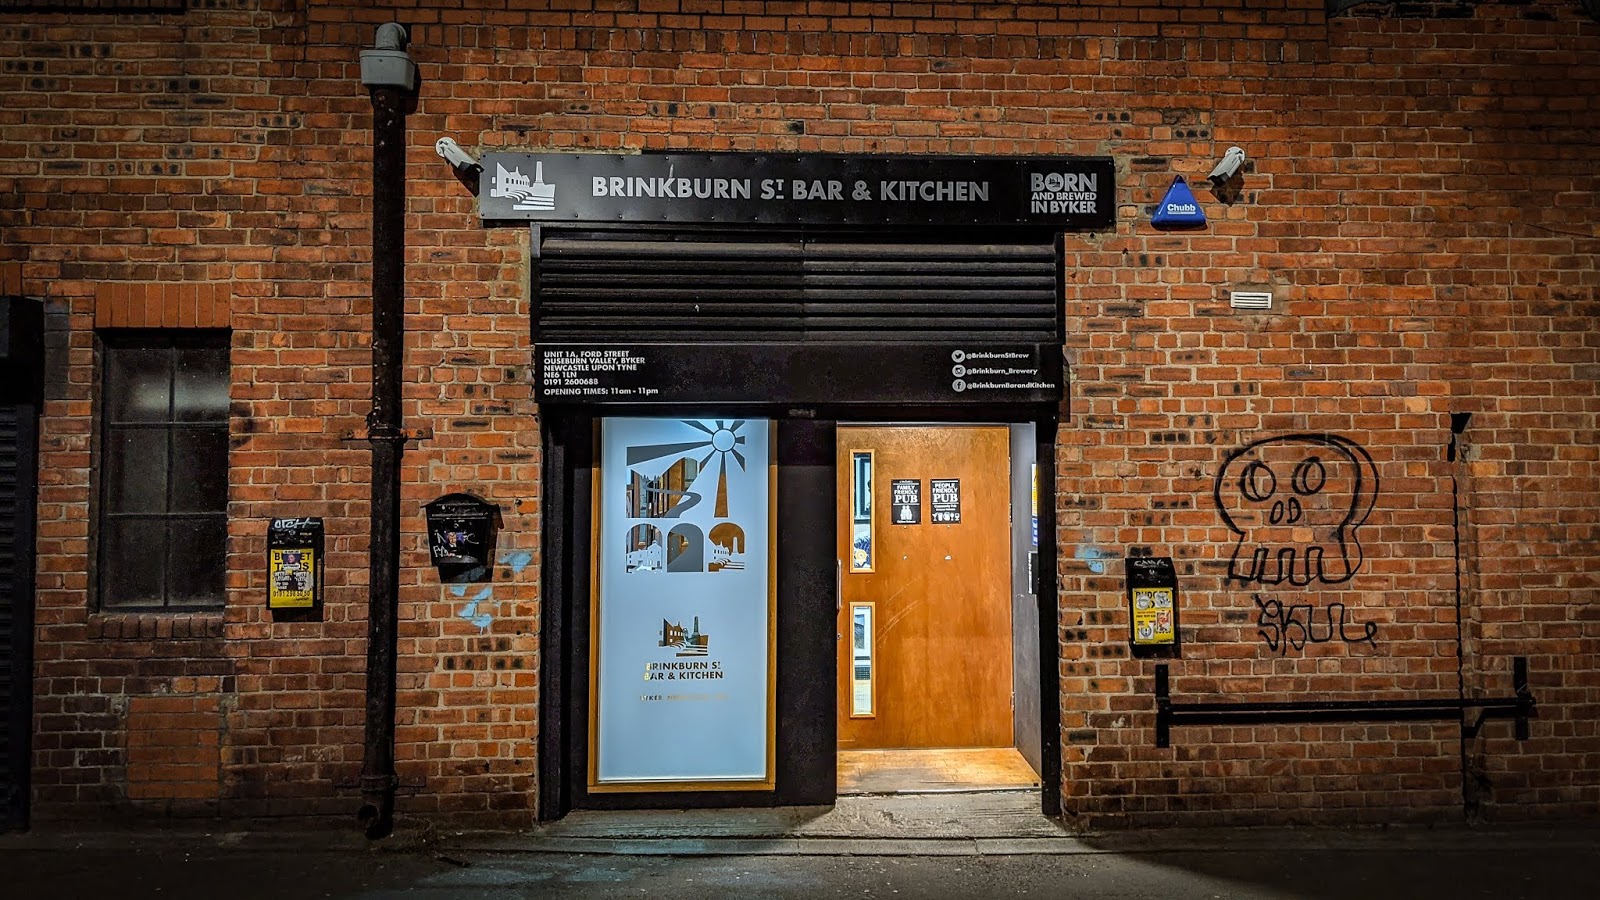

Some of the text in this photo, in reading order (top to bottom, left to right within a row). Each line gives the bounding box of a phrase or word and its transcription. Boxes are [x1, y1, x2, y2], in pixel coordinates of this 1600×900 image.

[1030, 172, 1098, 192] BORN
[592, 176, 751, 199] BRINKBURN
[793, 180, 844, 201] BAR
[852, 180, 872, 201] &
[881, 180, 990, 202] KITCHEN
[1031, 192, 1097, 201] AND BREWED
[1031, 201, 1097, 214] IN BYKER
[1167, 203, 1196, 212] Chubb
[638, 387, 659, 396] 11pm
[895, 495, 918, 503] PUB
[933, 494, 958, 502] PUB
[274, 552, 312, 561] BET
[274, 562, 310, 570] TIS
[646, 661, 708, 671] BRINKBURN
[644, 671, 723, 681] BAR & KITCHEN
